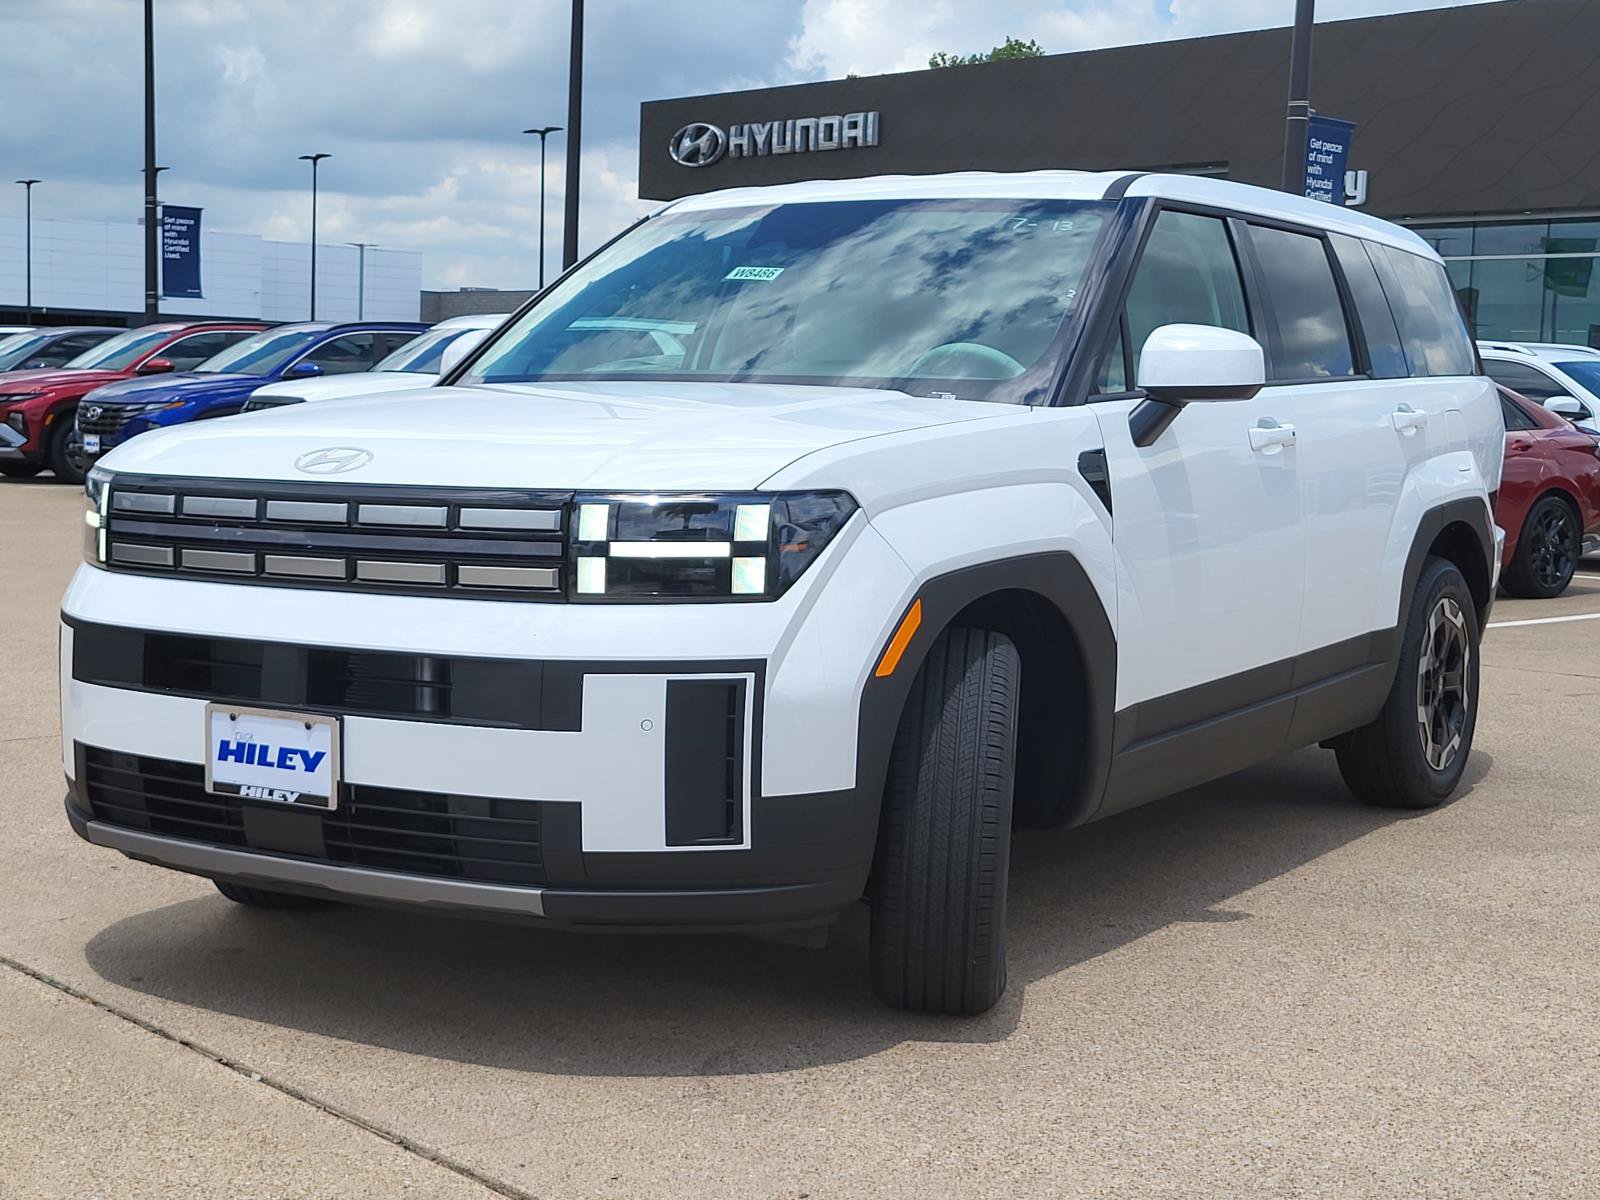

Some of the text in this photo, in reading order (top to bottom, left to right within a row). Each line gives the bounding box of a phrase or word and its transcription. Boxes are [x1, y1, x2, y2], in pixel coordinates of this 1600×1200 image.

[729, 111, 879, 158] HYUNDAI
[1310, 138, 1342, 153] Get peace
[1308, 151, 1333, 164] of mind
[1307, 164, 1322, 175] with
[1306, 176, 1333, 189] Hyundai
[1345, 170, 1368, 206] y
[733, 268, 778, 278] W8486
[217, 739, 327, 773] HILEY
[240, 784, 301, 802] HILEY
